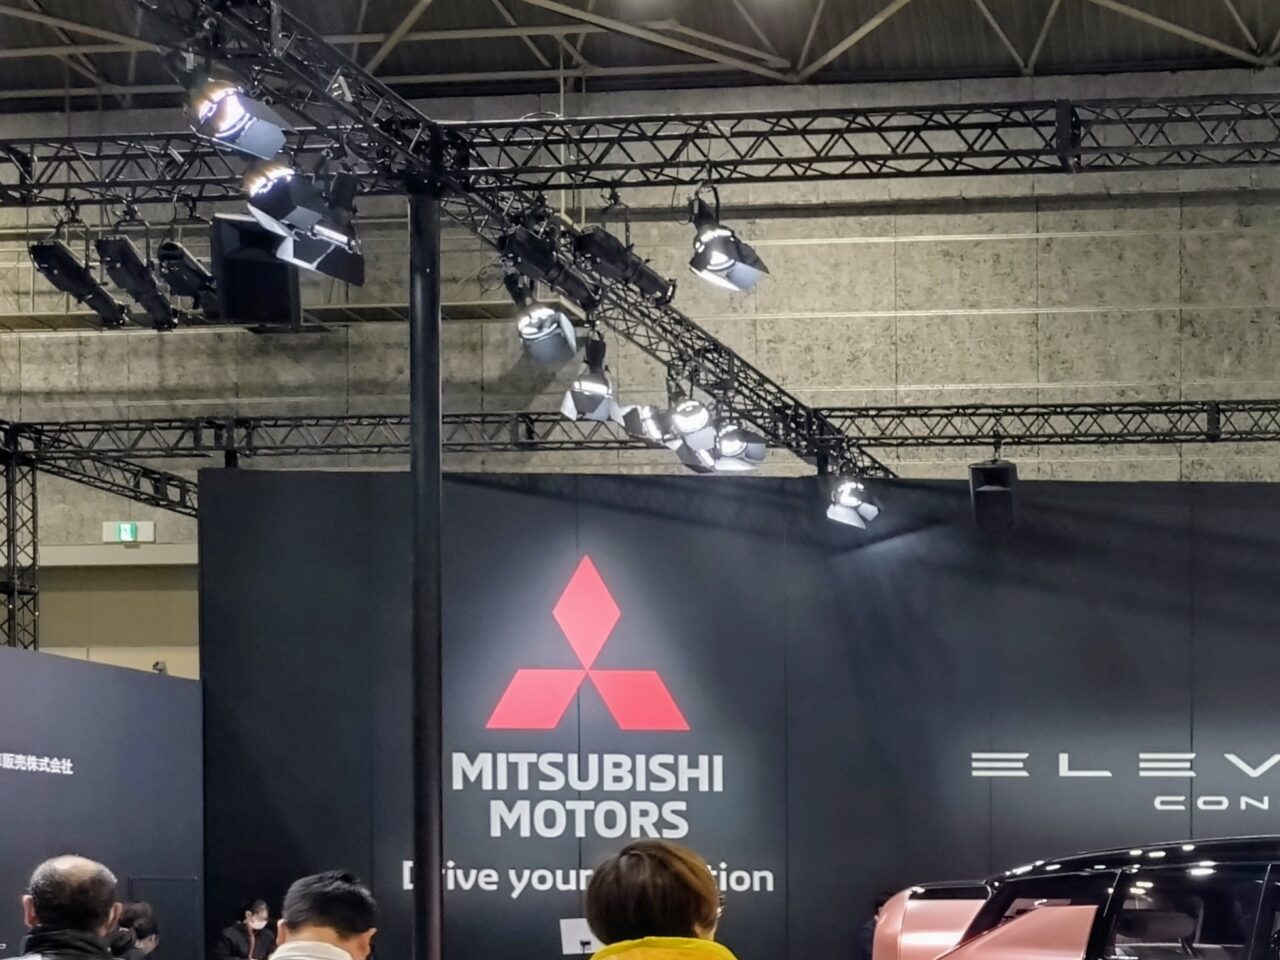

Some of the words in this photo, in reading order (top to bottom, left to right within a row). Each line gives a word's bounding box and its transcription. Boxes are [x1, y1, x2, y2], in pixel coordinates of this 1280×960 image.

[0, 752, 74, 775] 販売株式会社
[452, 752, 724, 791] MITSUBISHI
[489, 799, 690, 840] MOTORS
[402, 860, 500, 892] ive
[508, 868, 595, 900] your
